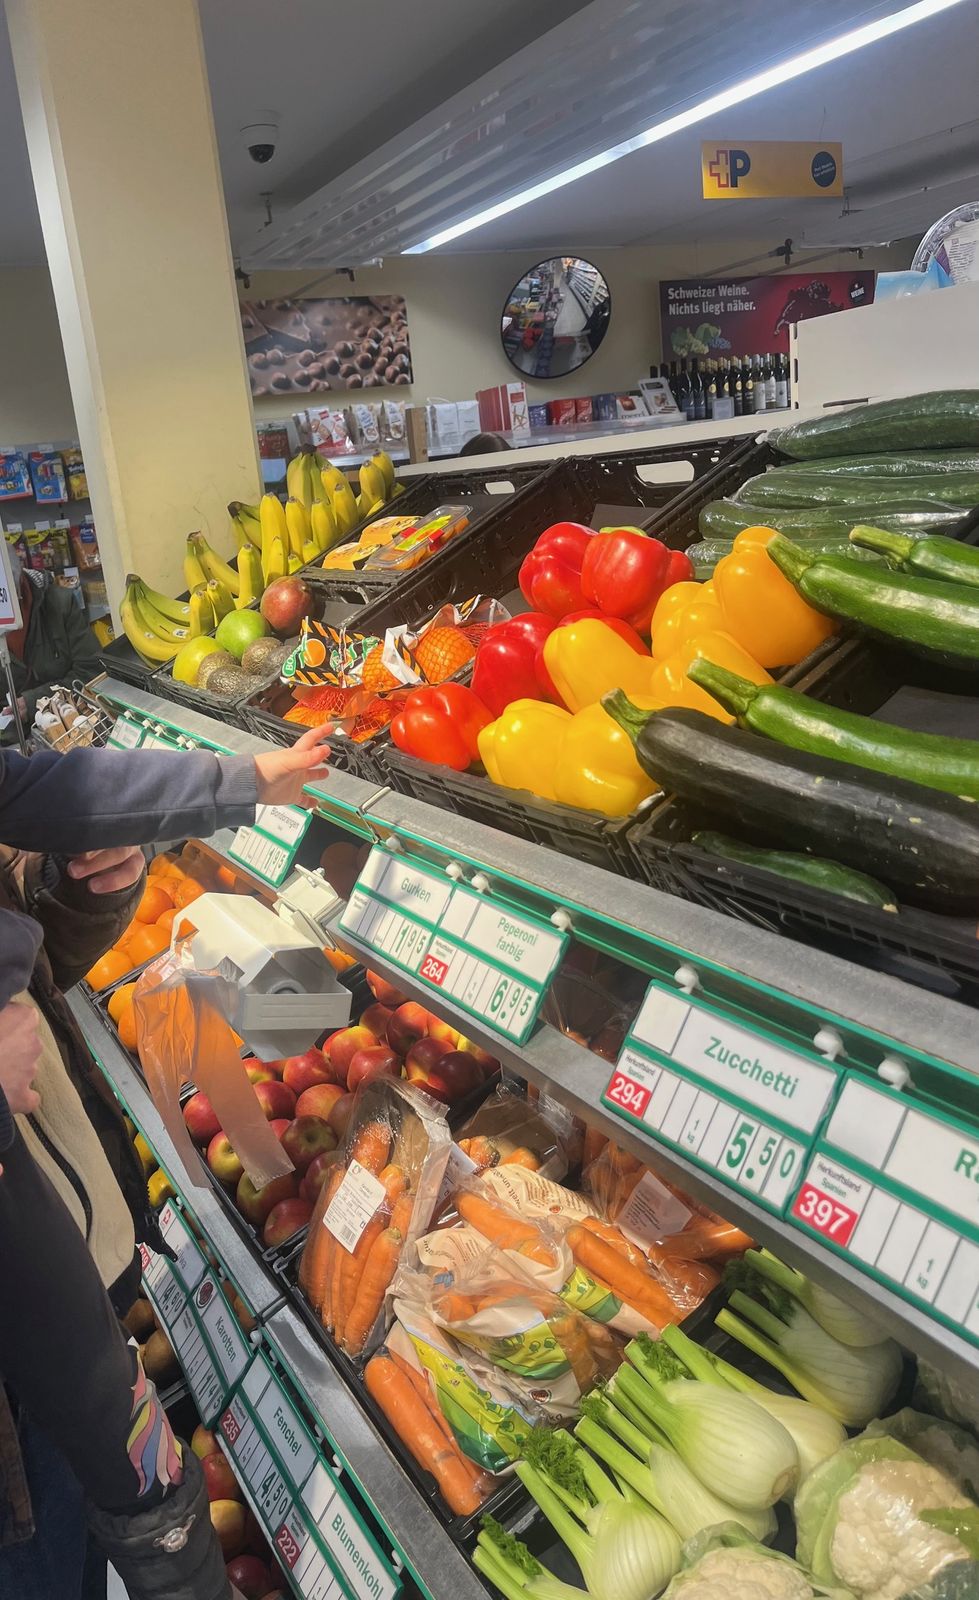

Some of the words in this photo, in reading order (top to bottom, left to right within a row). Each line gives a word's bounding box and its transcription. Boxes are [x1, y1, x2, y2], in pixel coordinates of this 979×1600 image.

[729, 149, 751, 188] P
[667, 285, 716, 300] Schweizer
[717, 283, 750, 298] Weine.
[668, 301, 700, 316] Nichts
[702, 300, 725, 316] liegt
[727, 299, 757, 312] näher.
[401, 878, 431, 903] Gurken
[497, 916, 538, 945] Peperoni
[495, 936, 525, 962] farbig
[422, 958, 446, 982] 264
[704, 1036, 799, 1099] Zucchetti
[610, 1076, 646, 1111] 294
[817, 1161, 862, 1193] Herkunftsland
[821, 1177, 847, 1198] Spanien
[799, 1189, 850, 1234] 397
[214, 1315, 237, 1363] Karotten
[222, 1413, 239, 1441] 235
[273, 1407, 302, 1457] Fenchel
[277, 1529, 297, 1564] 222
[331, 1513, 385, 1600] Blumenkohl
